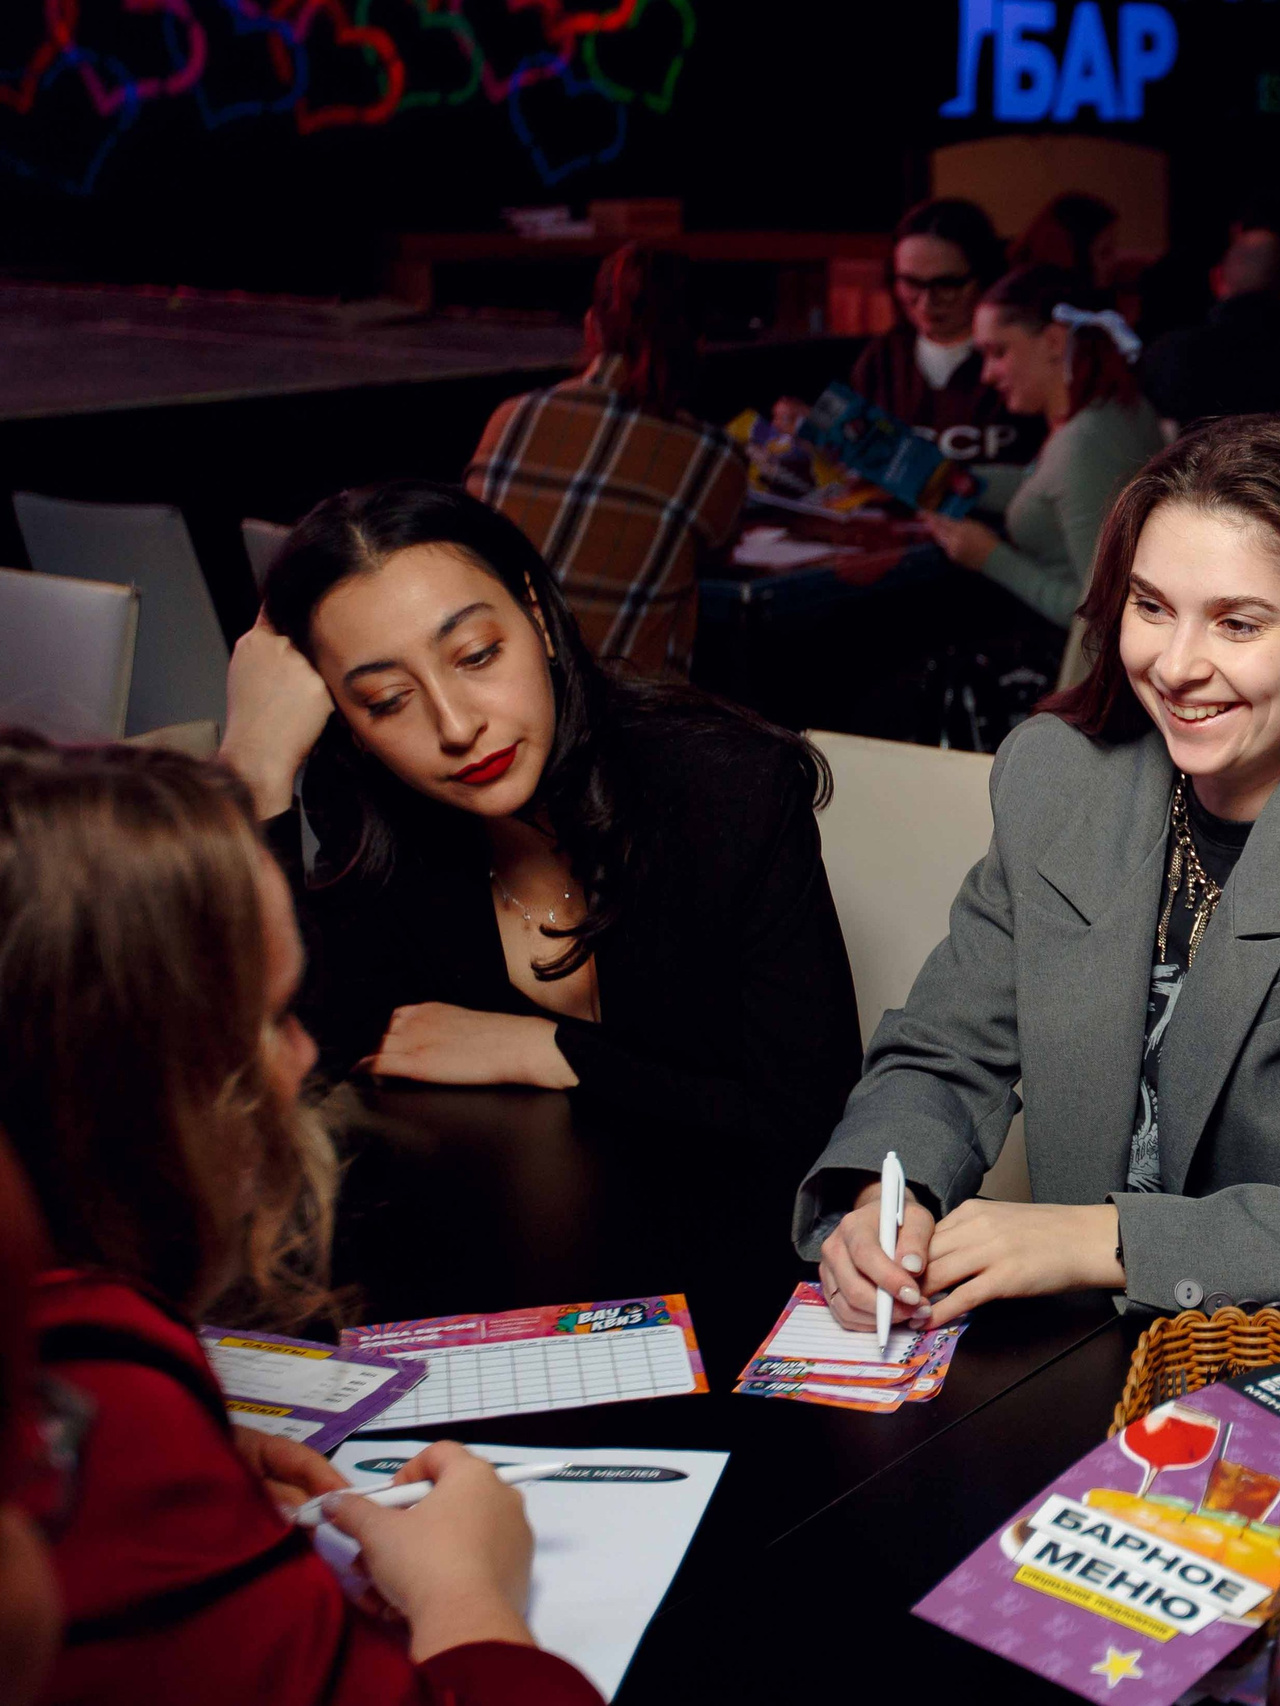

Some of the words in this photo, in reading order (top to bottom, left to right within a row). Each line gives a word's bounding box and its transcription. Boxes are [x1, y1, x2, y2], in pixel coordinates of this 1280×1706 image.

[911, 424, 1020, 460] СР
[577, 1307, 621, 1324] ВАУ
[591, 1313, 643, 1331] КВИЗ
[592, 1468, 661, 1479] МЫСЛЕЙ
[1052, 1508, 1245, 1602] БАРНОЕ
[1034, 1541, 1200, 1620] МЕНЮ
